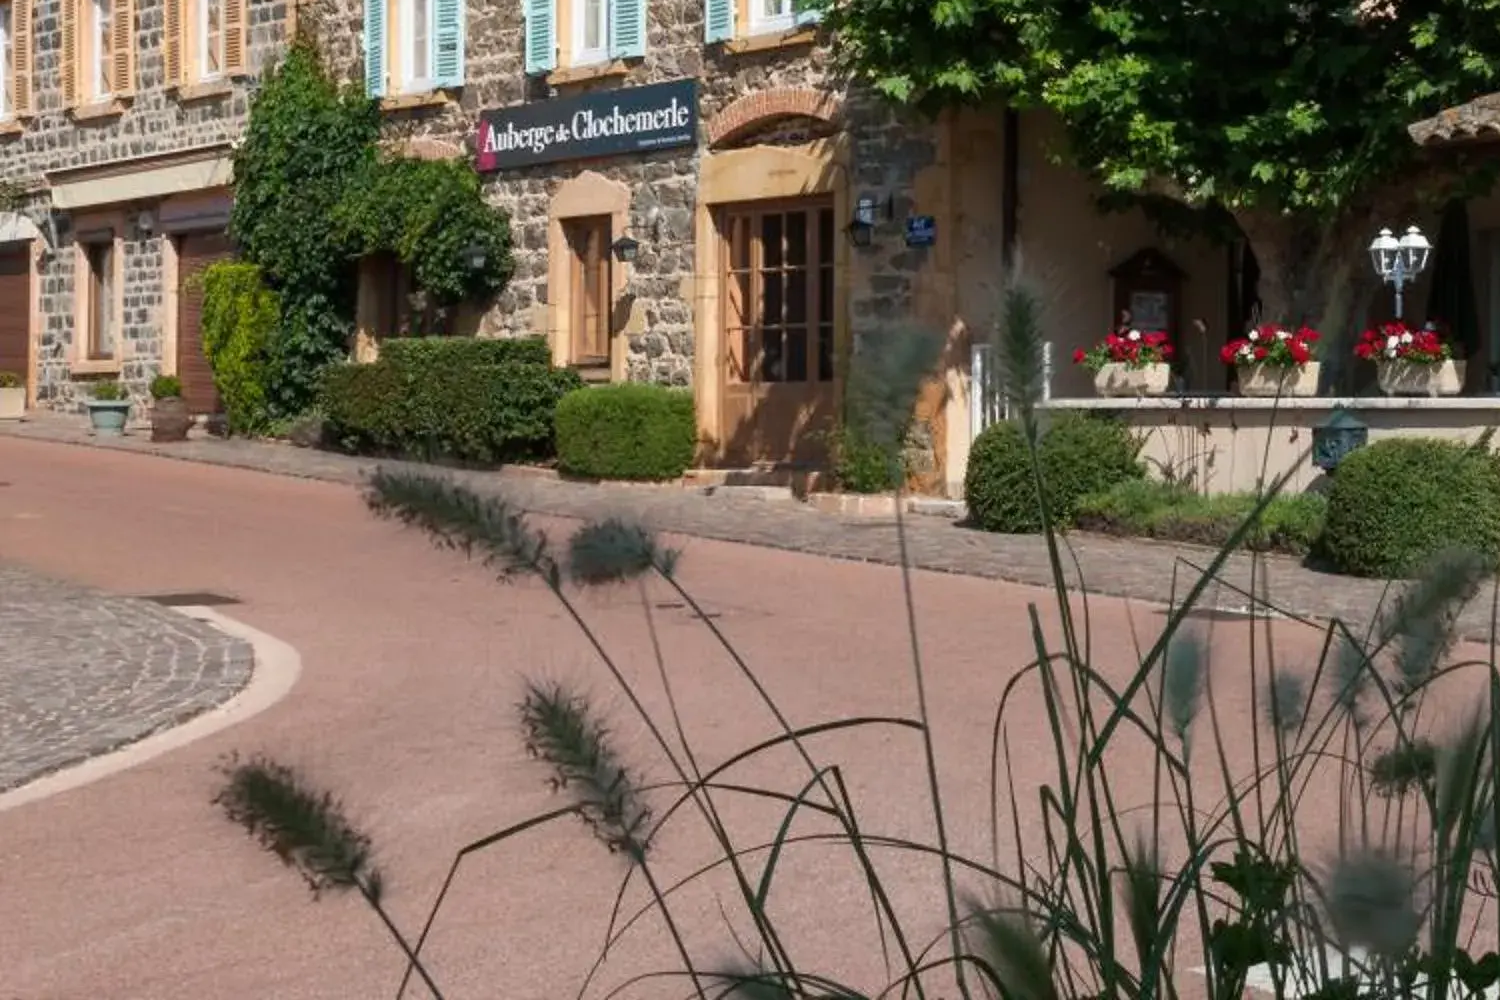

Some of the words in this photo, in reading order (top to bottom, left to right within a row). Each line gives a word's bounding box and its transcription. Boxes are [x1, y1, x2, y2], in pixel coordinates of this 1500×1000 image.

[483, 121, 554, 153] Auberge
[555, 123, 571, 143] de
[572, 96, 689, 141] Clochemerle
